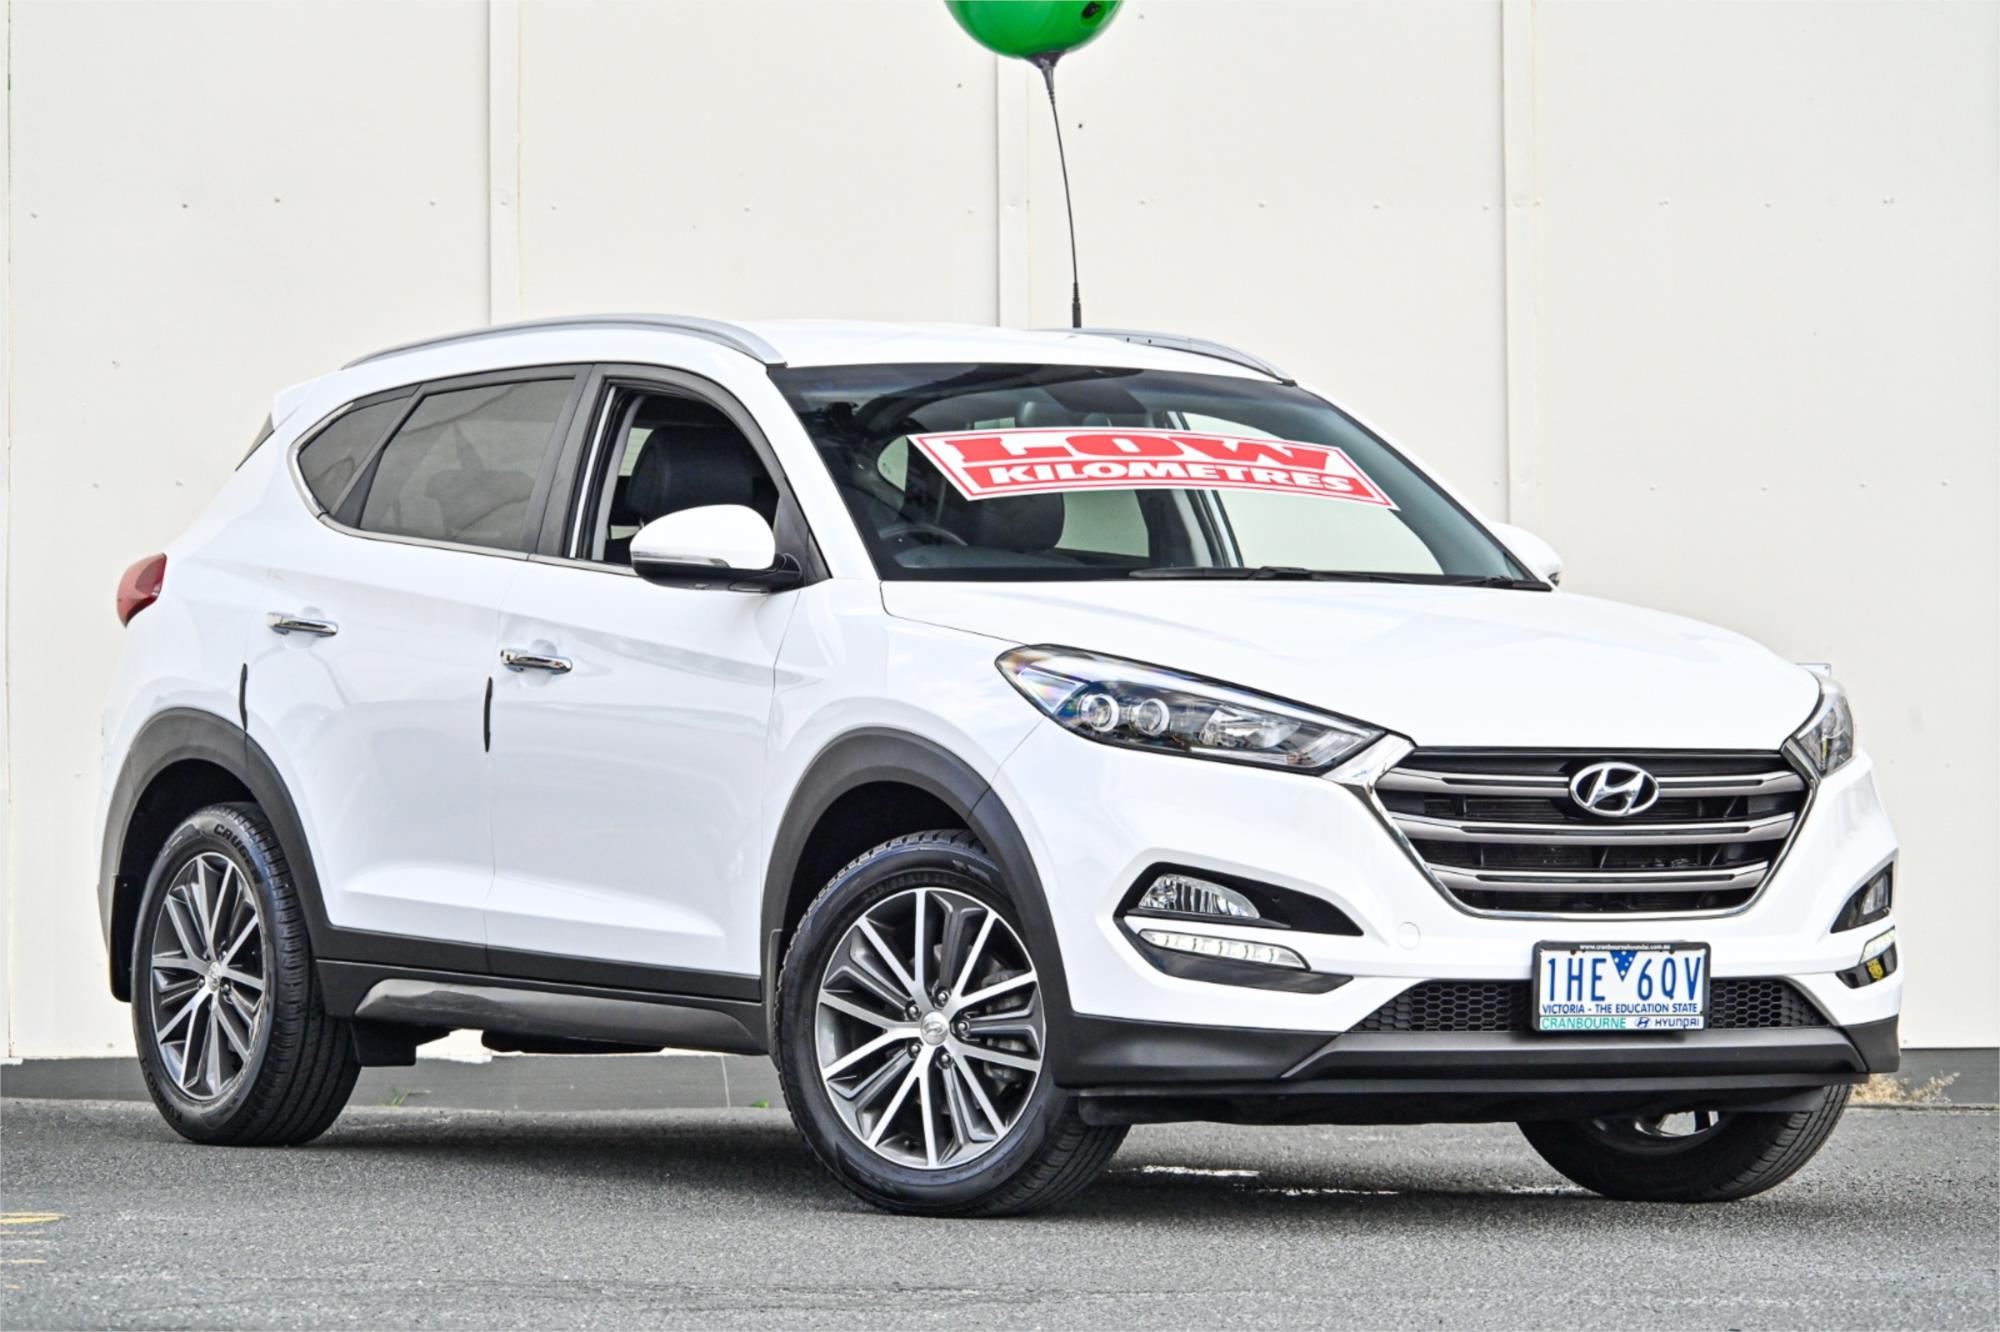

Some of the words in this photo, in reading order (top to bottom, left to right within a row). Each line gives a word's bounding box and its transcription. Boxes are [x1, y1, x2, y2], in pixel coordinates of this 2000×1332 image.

[944, 434, 1330, 470] LOW
[989, 460, 1354, 493] KILOMETRES
[1548, 957, 1607, 1002] 1HE
[1637, 956, 1701, 1001] 6QV
[1541, 1017, 1626, 1030] CRANBOURNE
[1654, 1017, 1700, 1029] HYUNDAI
[1542, 1003, 1585, 1014] VICTORIA
[1595, 1003, 1612, 1014] THE
[1615, 1003, 1669, 1014] EDUCATION
[1672, 1002, 1698, 1013] STATE
